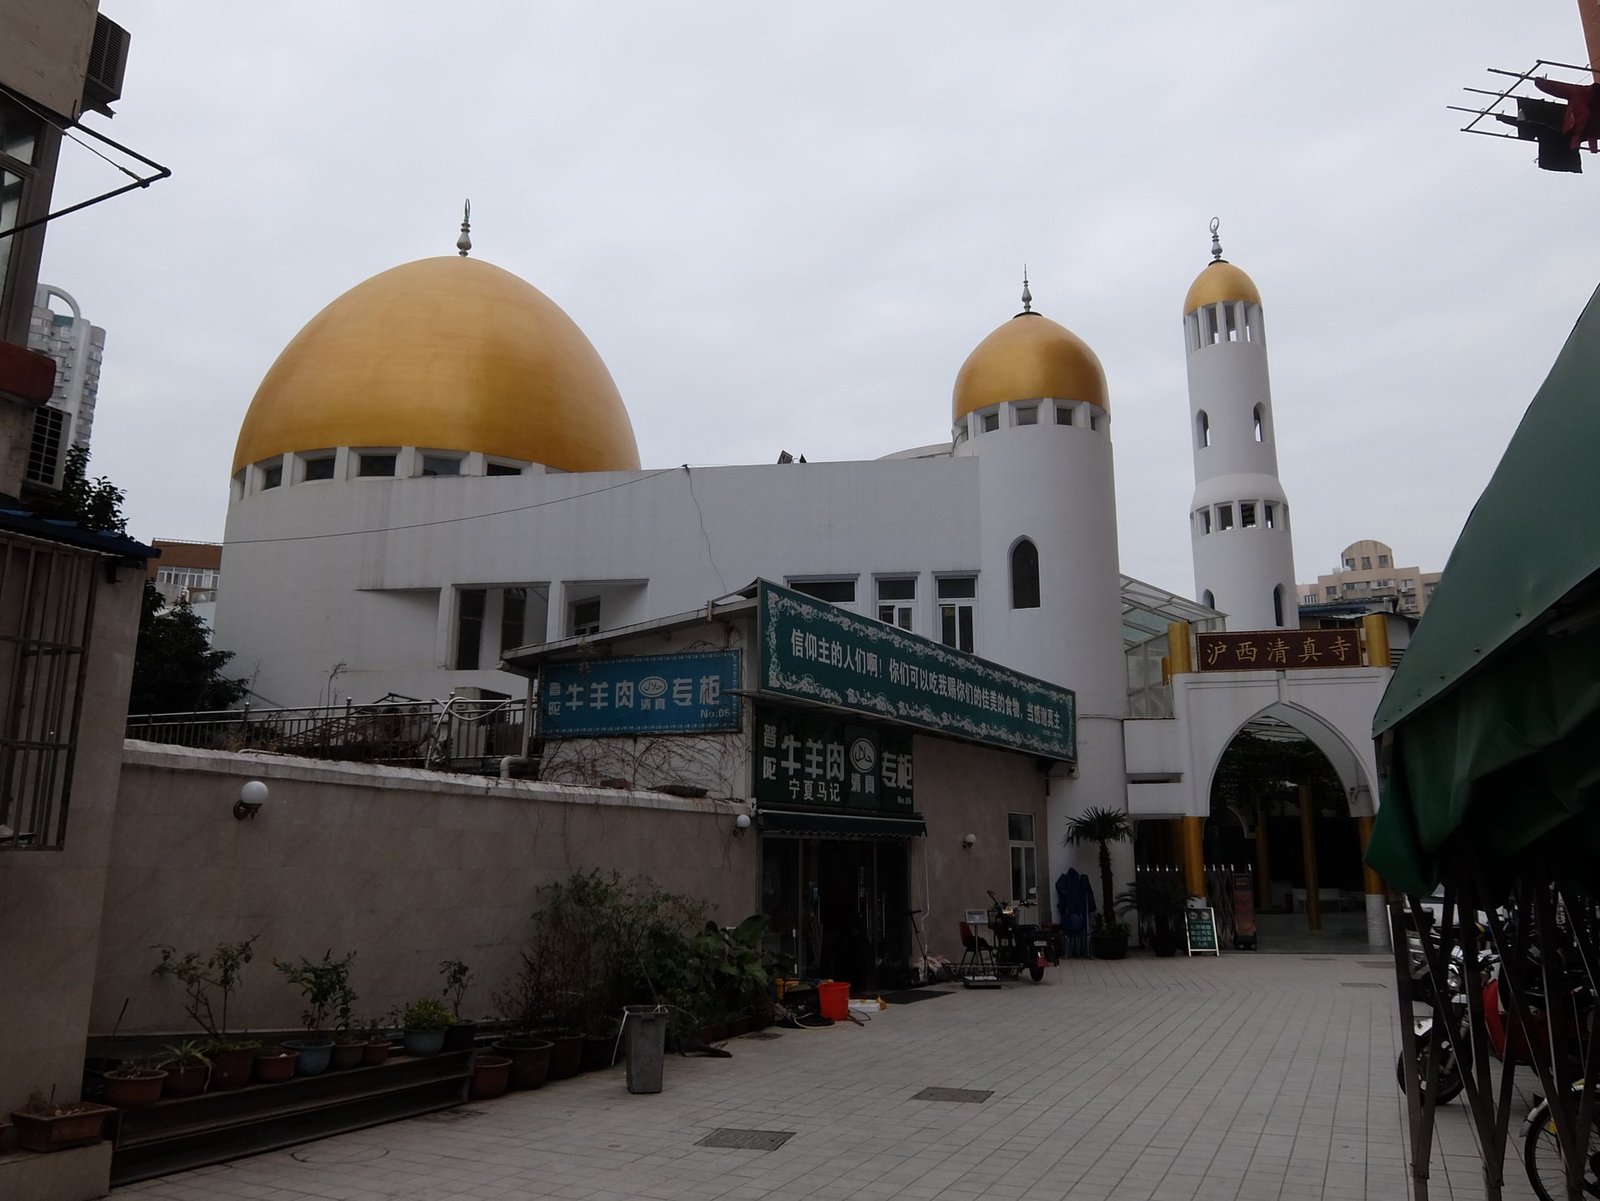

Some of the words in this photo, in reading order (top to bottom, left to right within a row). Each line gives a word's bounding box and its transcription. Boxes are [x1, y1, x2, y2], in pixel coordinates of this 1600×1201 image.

[1206, 635, 1352, 666] 沪西清真寺
[565, 680, 635, 711] 牛羊肉
[672, 675, 720, 706] 专柜
[763, 724, 777, 780] 普陀
[781, 734, 845, 782] 牛羊肉
[881, 751, 913, 790] 专柜
[788, 778, 841, 803] 宁夏马记
